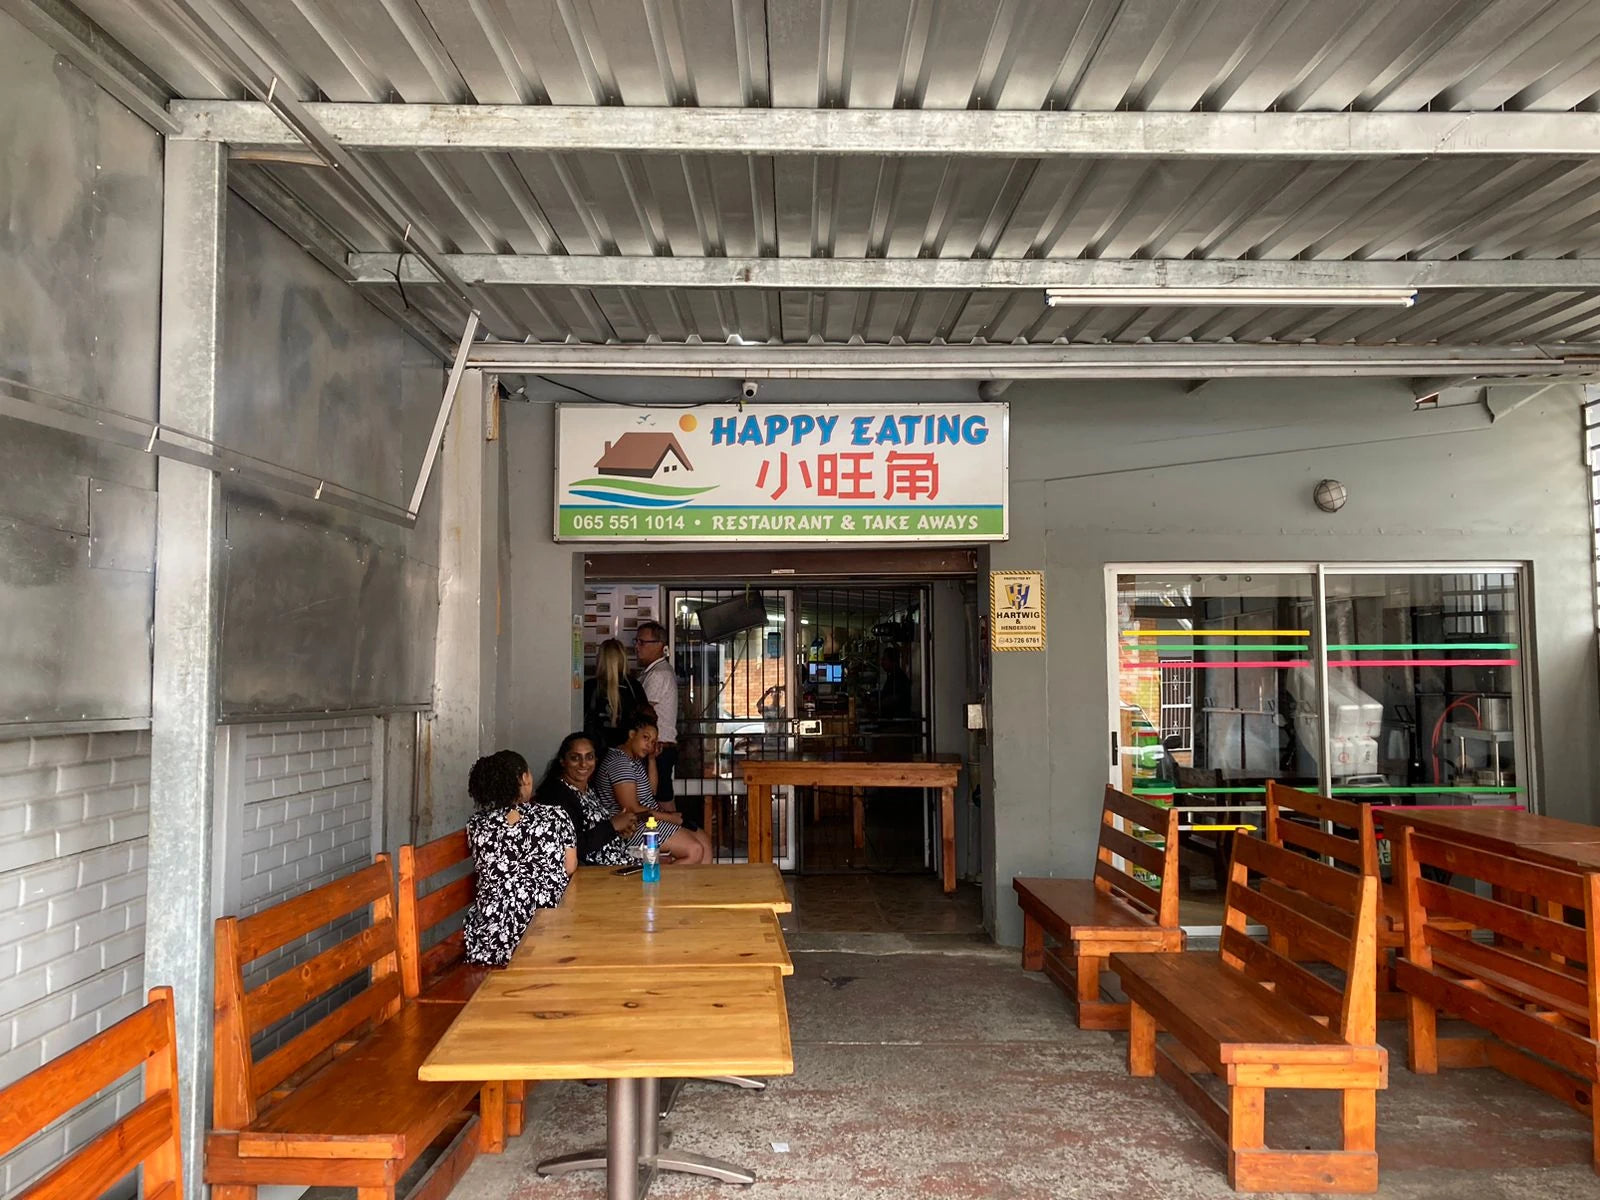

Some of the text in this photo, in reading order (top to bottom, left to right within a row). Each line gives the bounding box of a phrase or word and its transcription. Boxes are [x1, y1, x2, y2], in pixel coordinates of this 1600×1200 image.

[711, 414, 989, 446] HAPPY EATING
[755, 450, 939, 500] 小旺角
[573, 515, 685, 530] 065 551 1014
[711, 514, 979, 530] RESTAURANT & TAKE AWAYS
[996, 611, 1040, 619] HARTWIG
